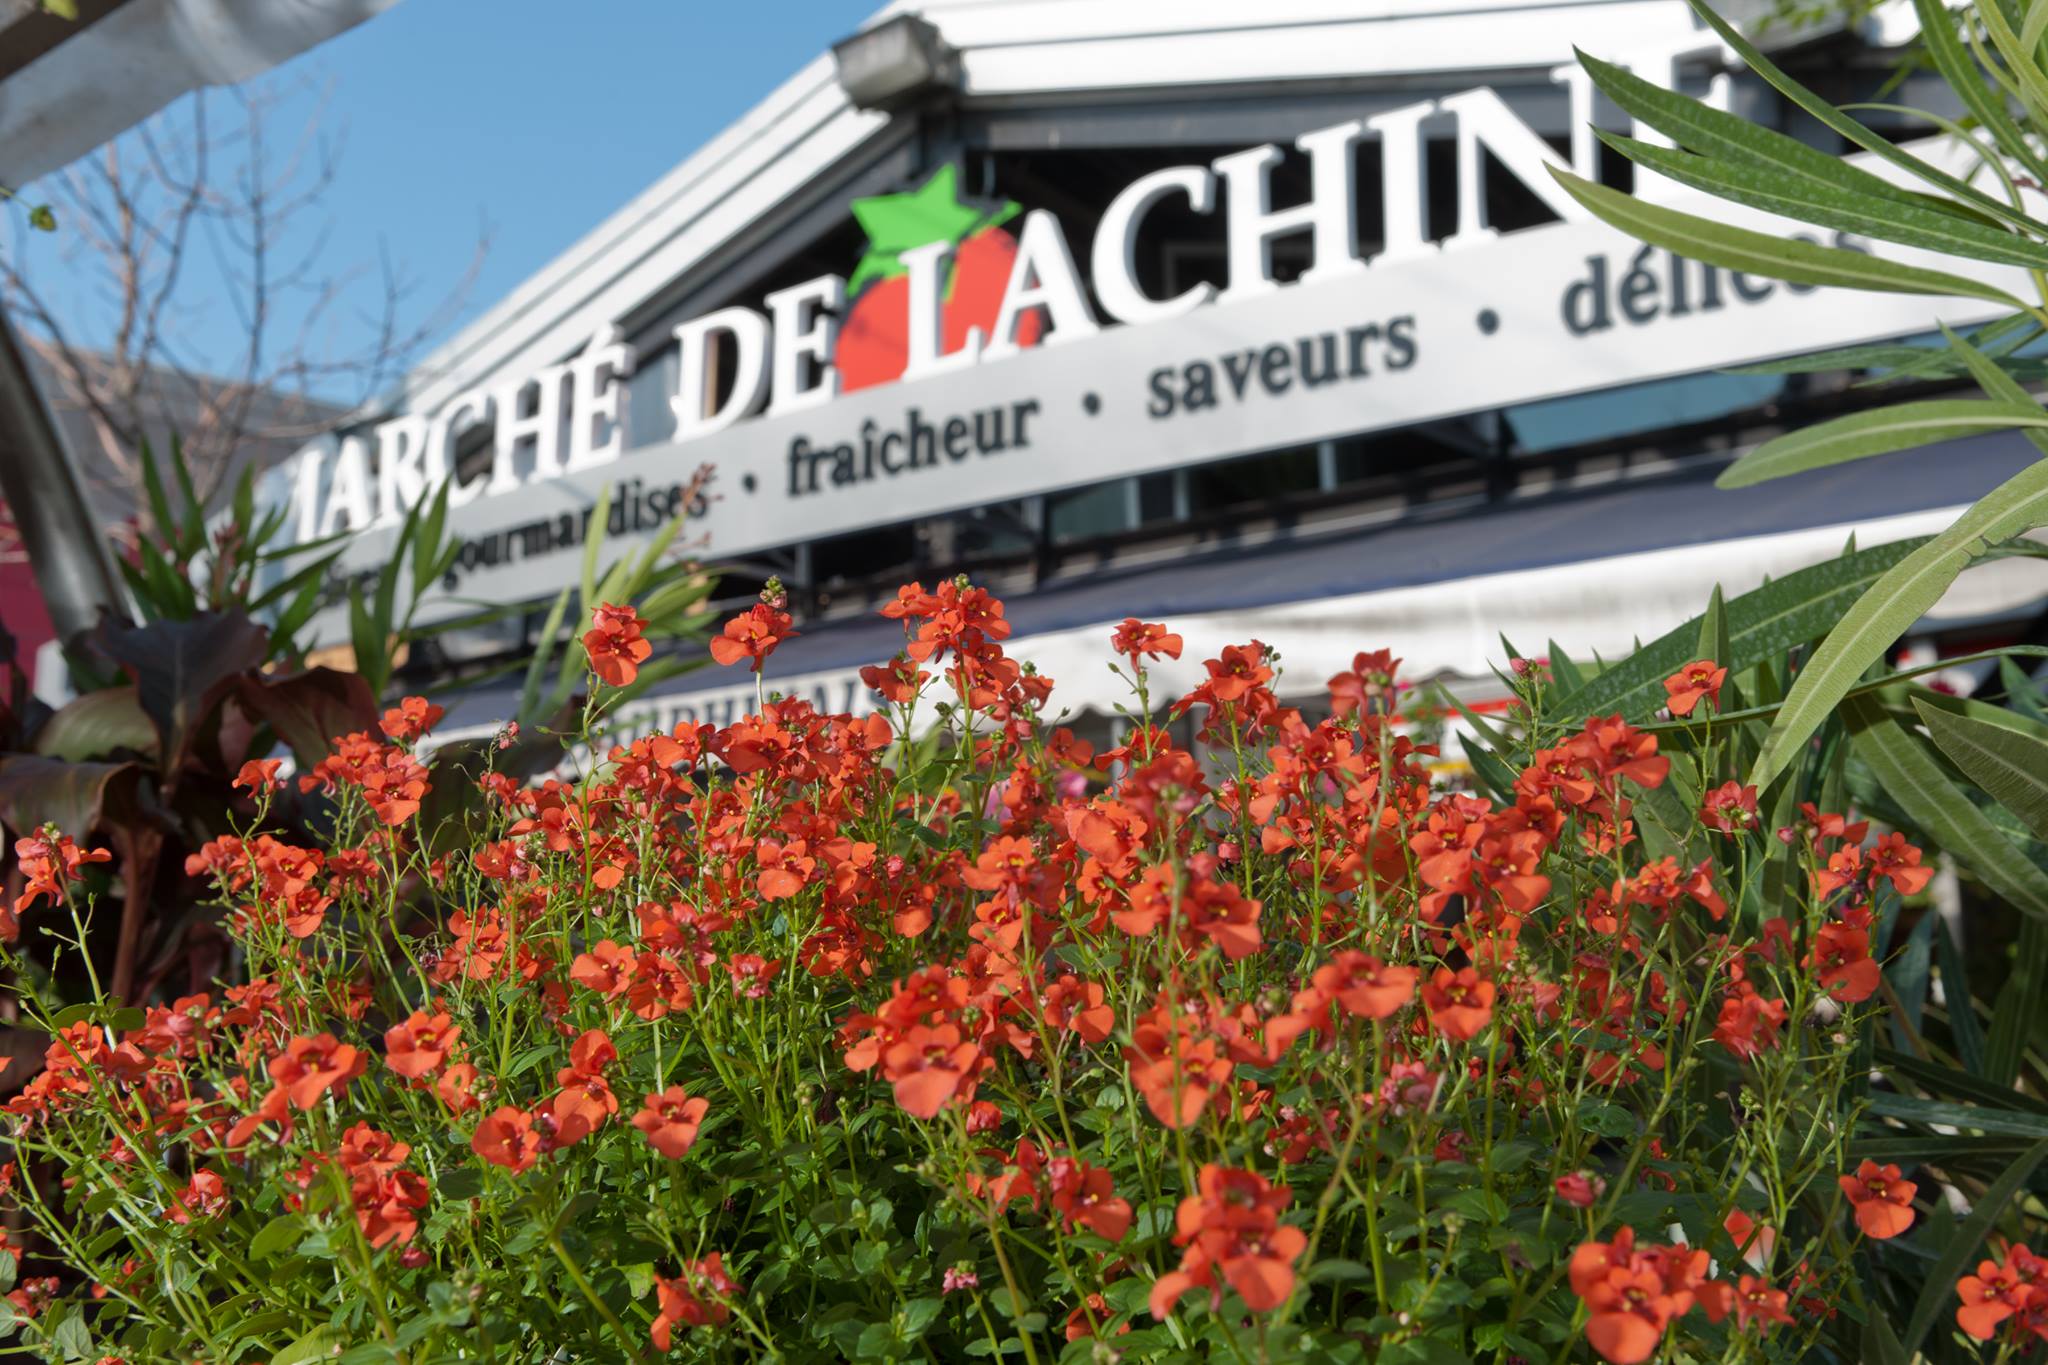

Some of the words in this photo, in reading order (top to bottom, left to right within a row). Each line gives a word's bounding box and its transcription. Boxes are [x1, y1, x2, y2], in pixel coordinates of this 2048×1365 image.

[670, 273, 847, 444] DE
[786, 398, 1040, 498] fraîcheur
[1146, 311, 1418, 421] saveurs
